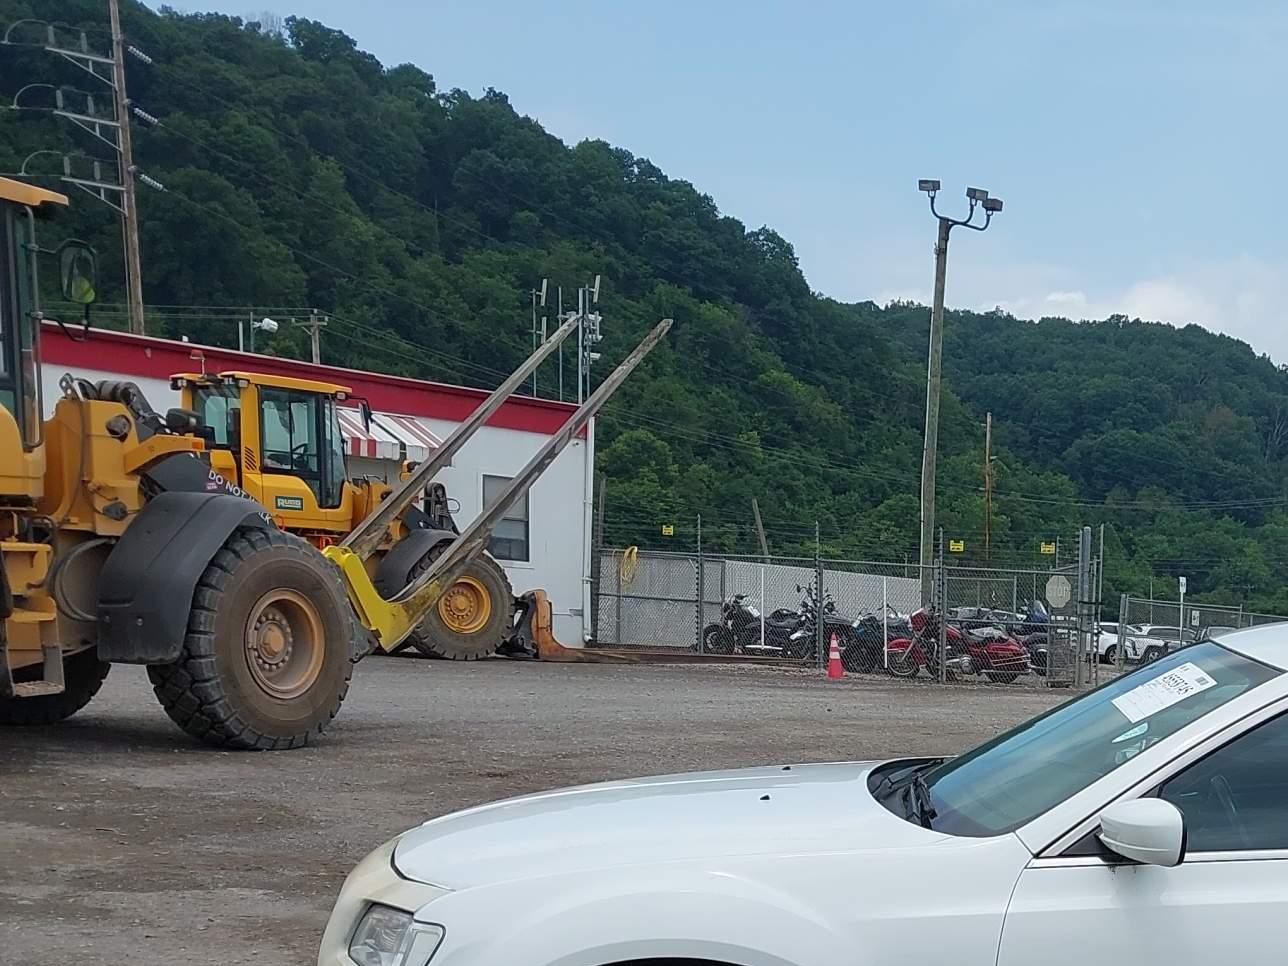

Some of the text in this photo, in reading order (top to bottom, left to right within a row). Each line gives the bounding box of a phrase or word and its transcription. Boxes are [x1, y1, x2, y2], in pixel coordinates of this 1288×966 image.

[208, 470, 224, 485] DO
[225, 480, 247, 499] NOT
[1047, 585, 1070, 597] STOP
